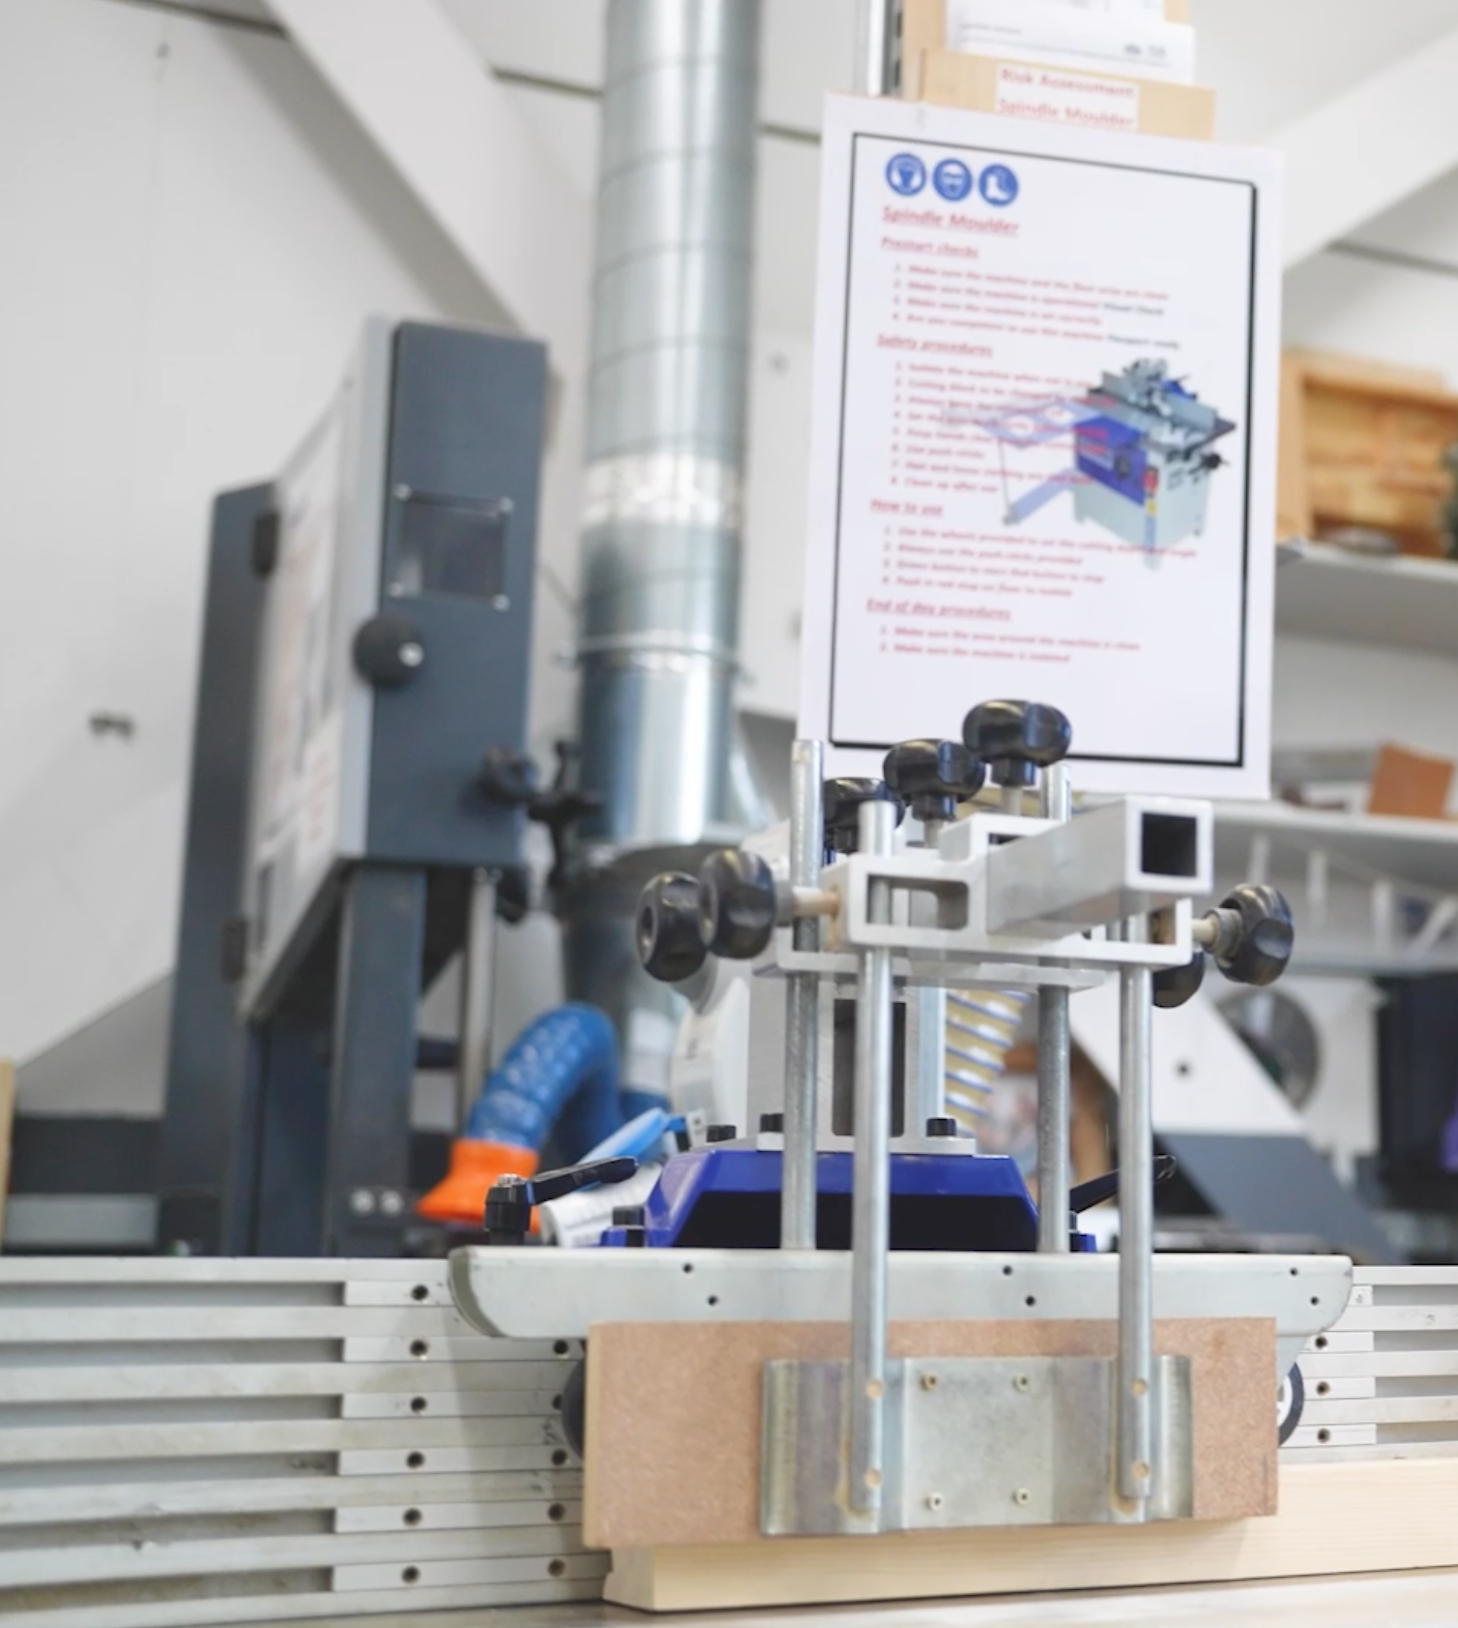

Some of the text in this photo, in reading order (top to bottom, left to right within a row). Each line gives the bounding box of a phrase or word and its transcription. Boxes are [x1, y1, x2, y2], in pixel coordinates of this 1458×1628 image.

[1001, 68, 1134, 98] Risk Assessment
[1000, 98, 1134, 126] Spindle Moulder
[883, 205, 1019, 235] Spindle Moulder
[878, 334, 992, 358] Safety procedures
[871, 500, 900, 512] How
[867, 599, 892, 612] End
[895, 601, 909, 614] of
[938, 606, 1011, 620] procedures
